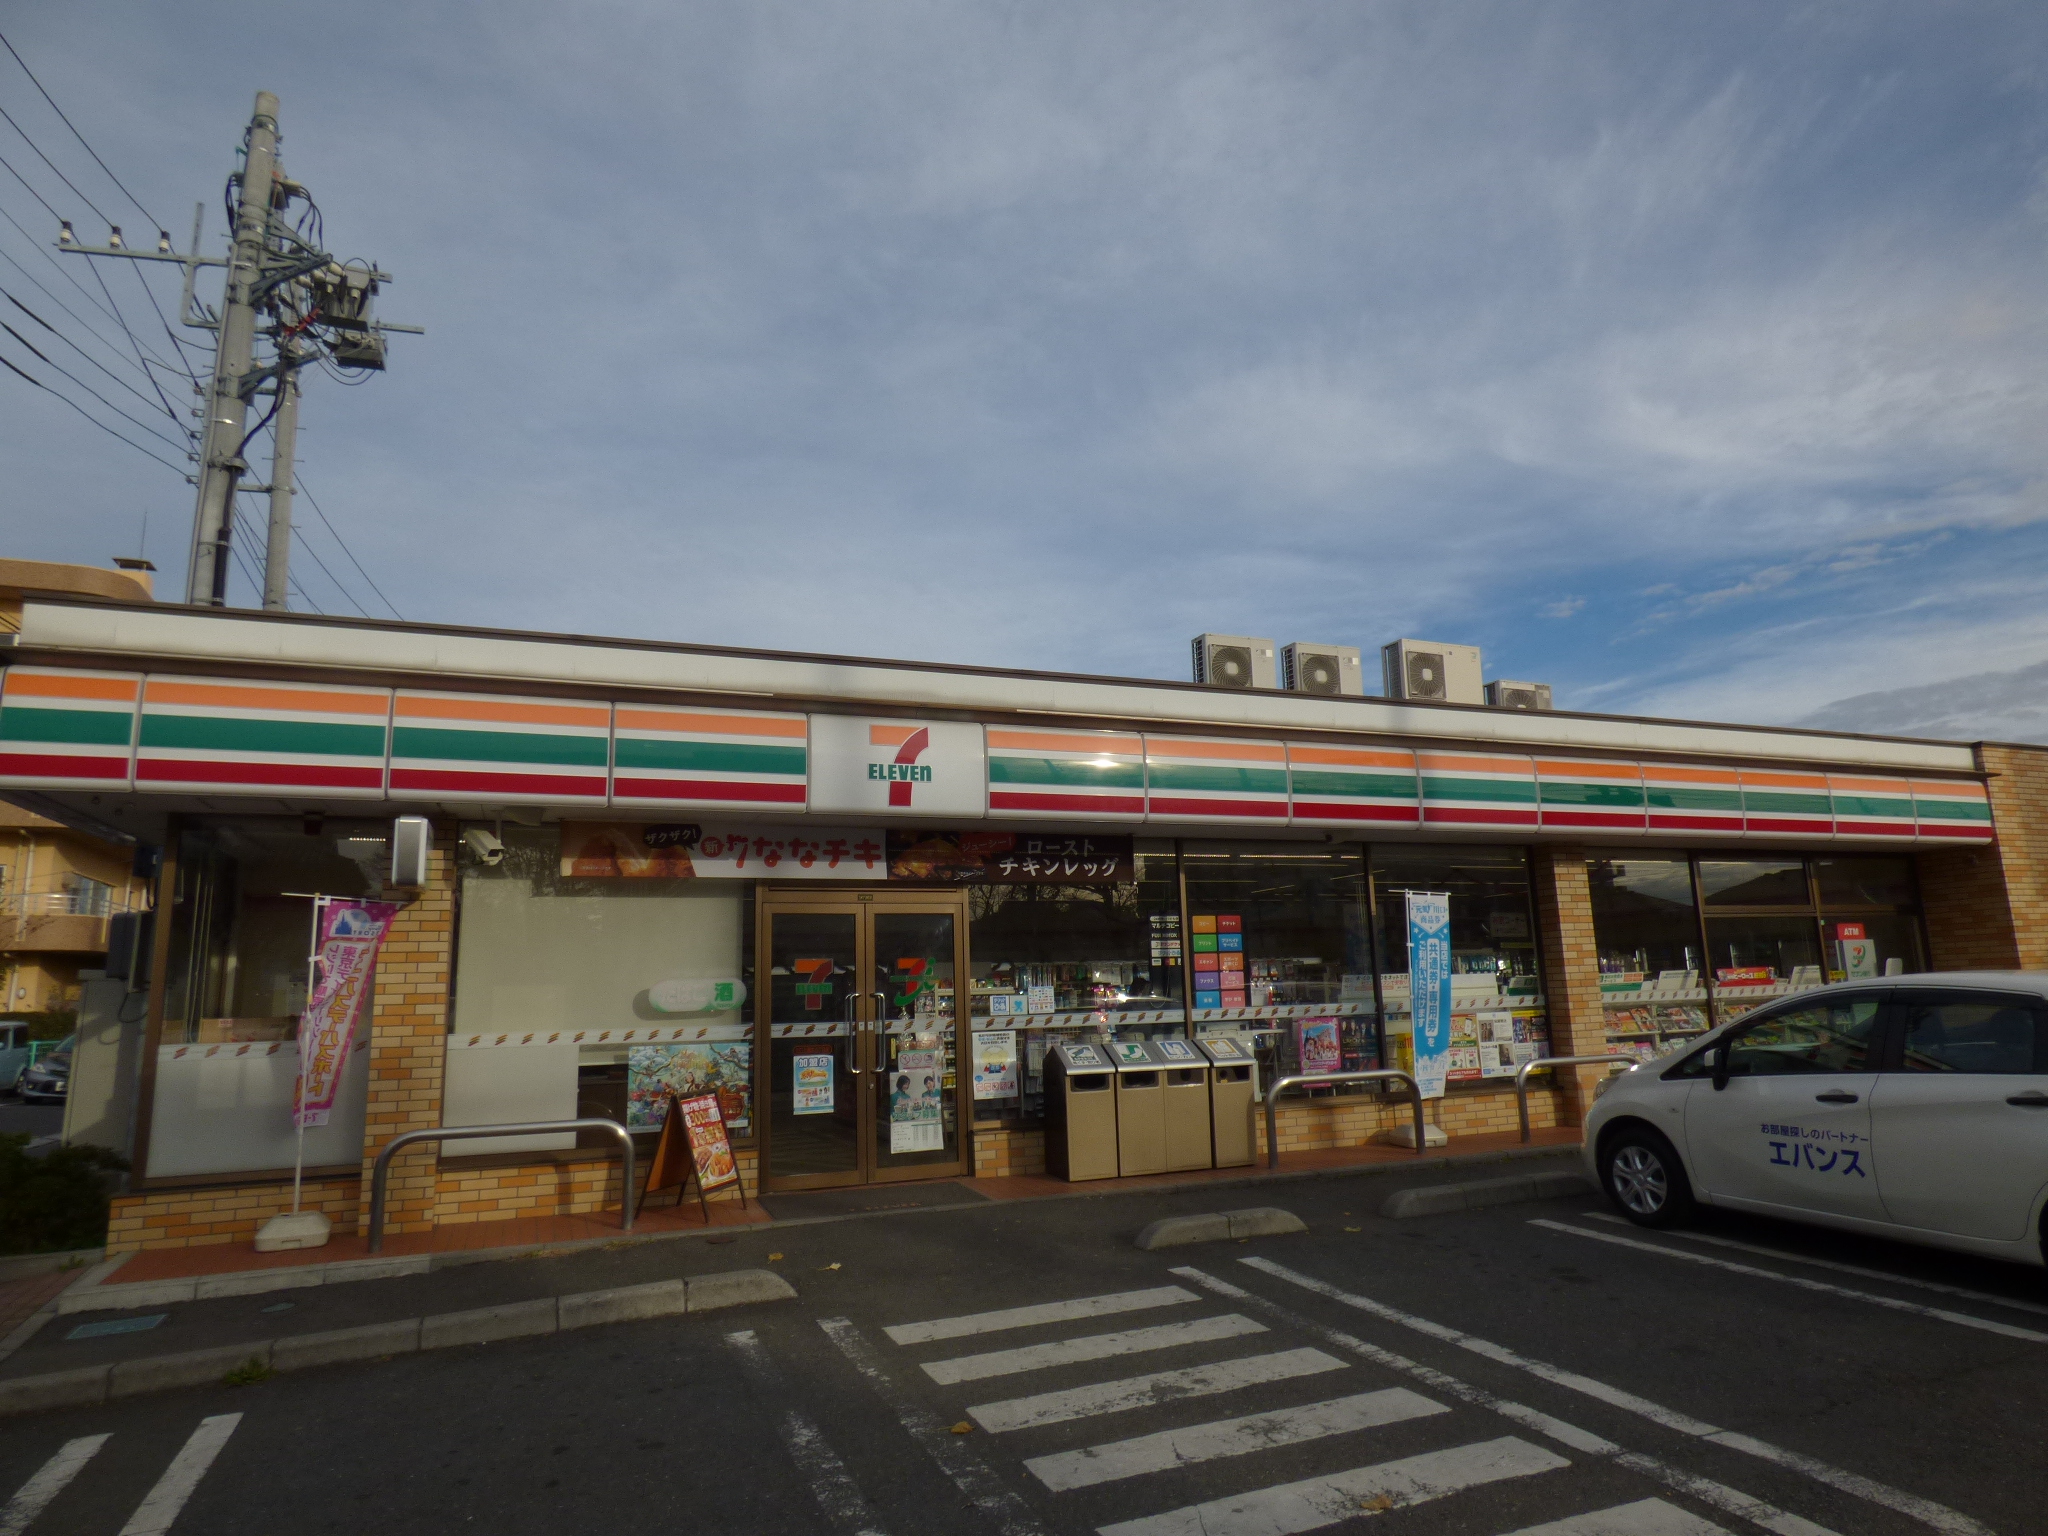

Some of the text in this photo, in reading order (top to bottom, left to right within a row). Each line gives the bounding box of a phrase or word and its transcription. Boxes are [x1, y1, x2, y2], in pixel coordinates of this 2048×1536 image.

[1027, 840, 1096, 857] ロースト
[998, 857, 1119, 877] チキンレッグ
[1843, 927, 1860, 936] ATM
[714, 982, 734, 1002] 酒
[797, 1056, 829, 1068] 加盟店
[1760, 1123, 1869, 1144] お部屋探しのパートナー
[1768, 1141, 1866, 1178] エバンス
